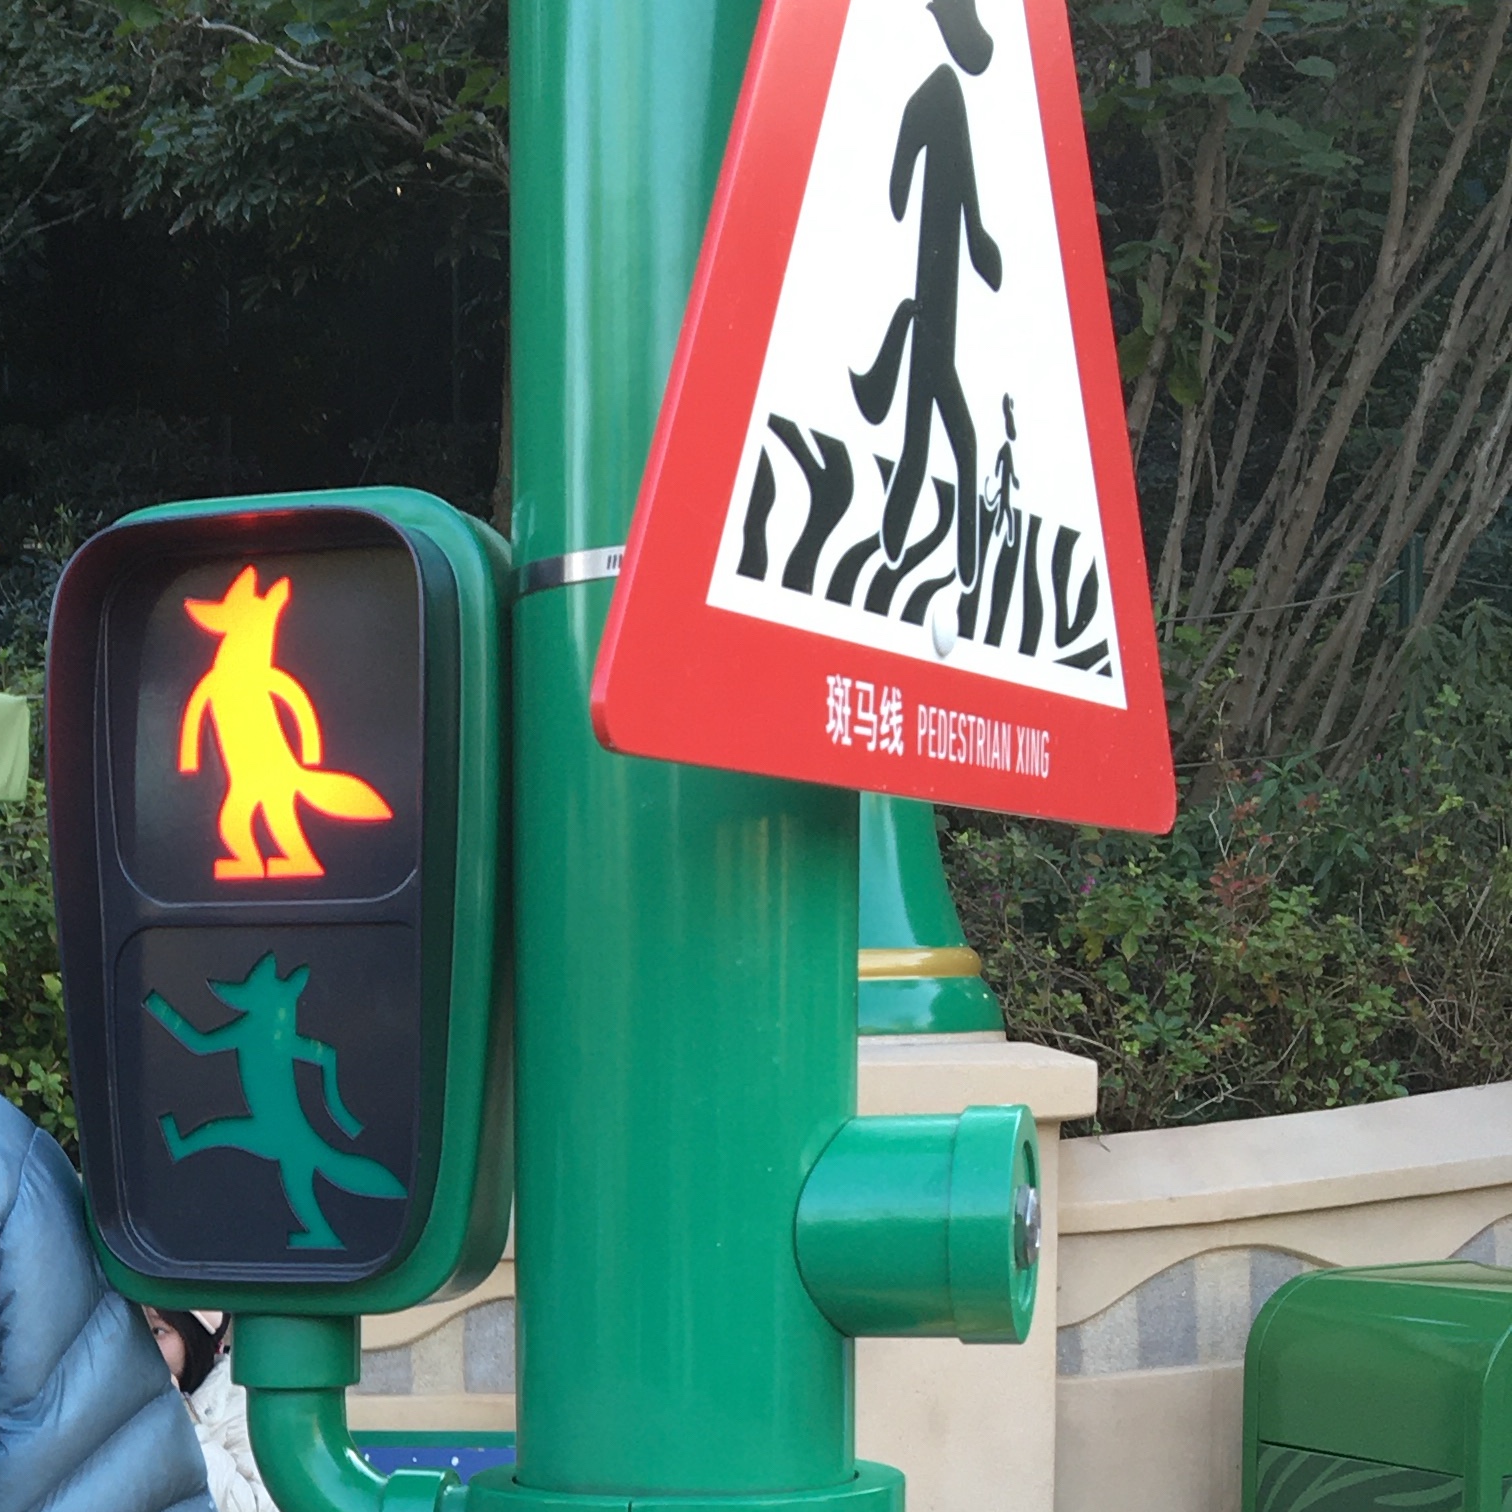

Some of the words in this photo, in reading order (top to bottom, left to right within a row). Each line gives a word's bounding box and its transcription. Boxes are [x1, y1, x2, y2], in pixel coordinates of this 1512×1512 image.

[825, 673, 904, 757] 斑马线
[917, 704, 1011, 772] PEDESTRIAN
[1015, 725, 1050, 779] XING
